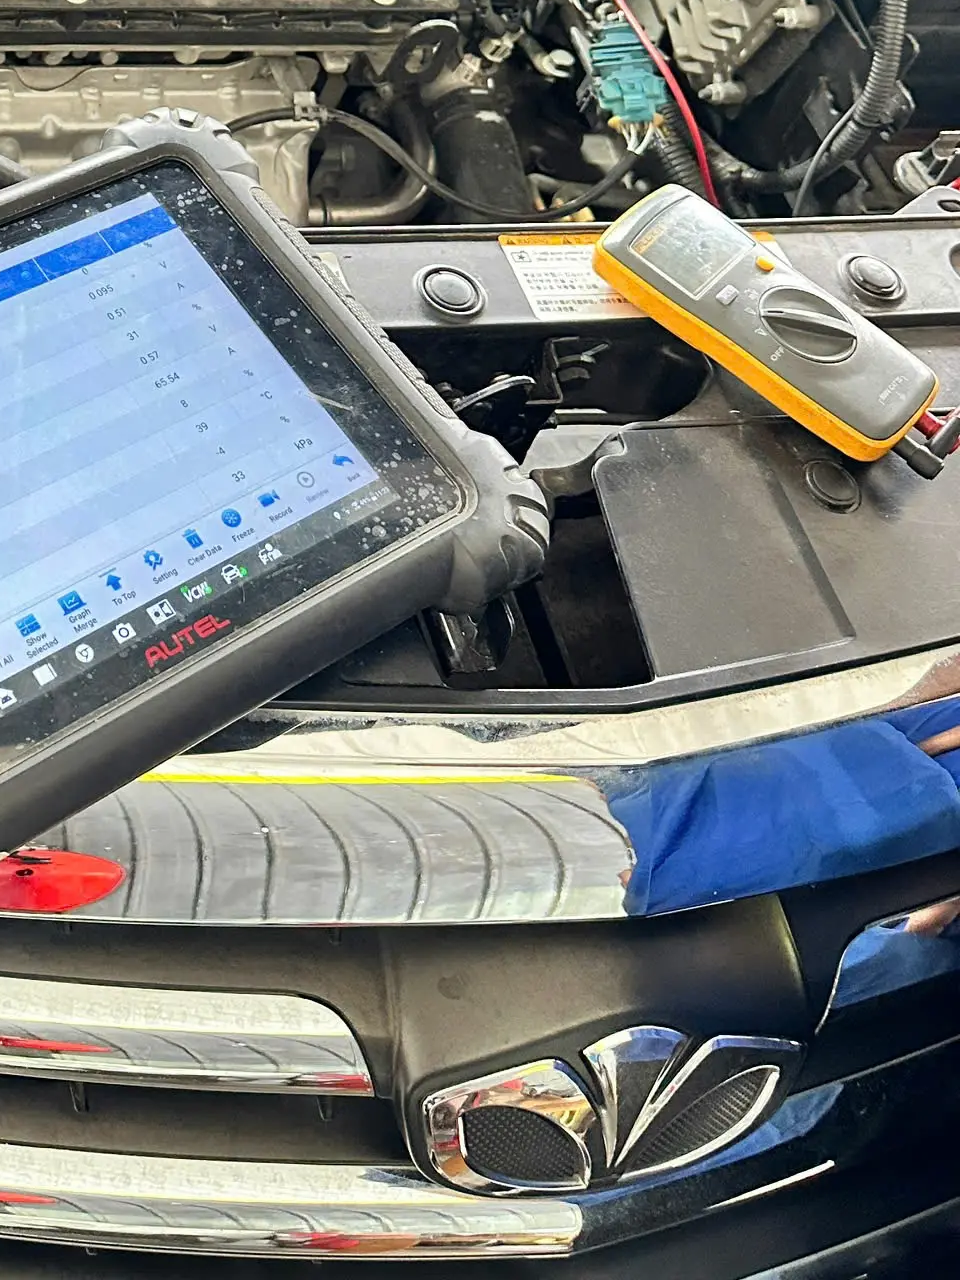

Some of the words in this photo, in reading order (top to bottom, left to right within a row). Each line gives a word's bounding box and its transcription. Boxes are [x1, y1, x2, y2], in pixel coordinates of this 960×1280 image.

[81, 267, 89, 276] 0
[159, 260, 167, 269] V
[176, 281, 185, 290] A
[126, 330, 140, 341] 31
[208, 324, 217, 333] V
[227, 346, 236, 355] A
[769, 345, 787, 362] OFF
[154, 372, 180, 389] 65.54
[180, 399, 189, 408] 8
[195, 421, 209, 433] 39
[293, 437, 314, 451] kPa
[231, 470, 246, 483] 33
[268, 506, 294, 523] Record
[231, 527, 256, 543] Freeze
[187, 552, 205, 567] Clear
[205, 544, 223, 558] Data
[152, 567, 179, 585] Setting
[111, 595, 123, 607] To
[123, 589, 137, 604] Top
[68, 607, 92, 624] Graph
[73, 617, 98, 634] Merge
[25, 631, 48, 647] Show
[144, 613, 232, 668] AUTEL
[26, 637, 59, 659] Selected
[2, 654, 15, 665] All
